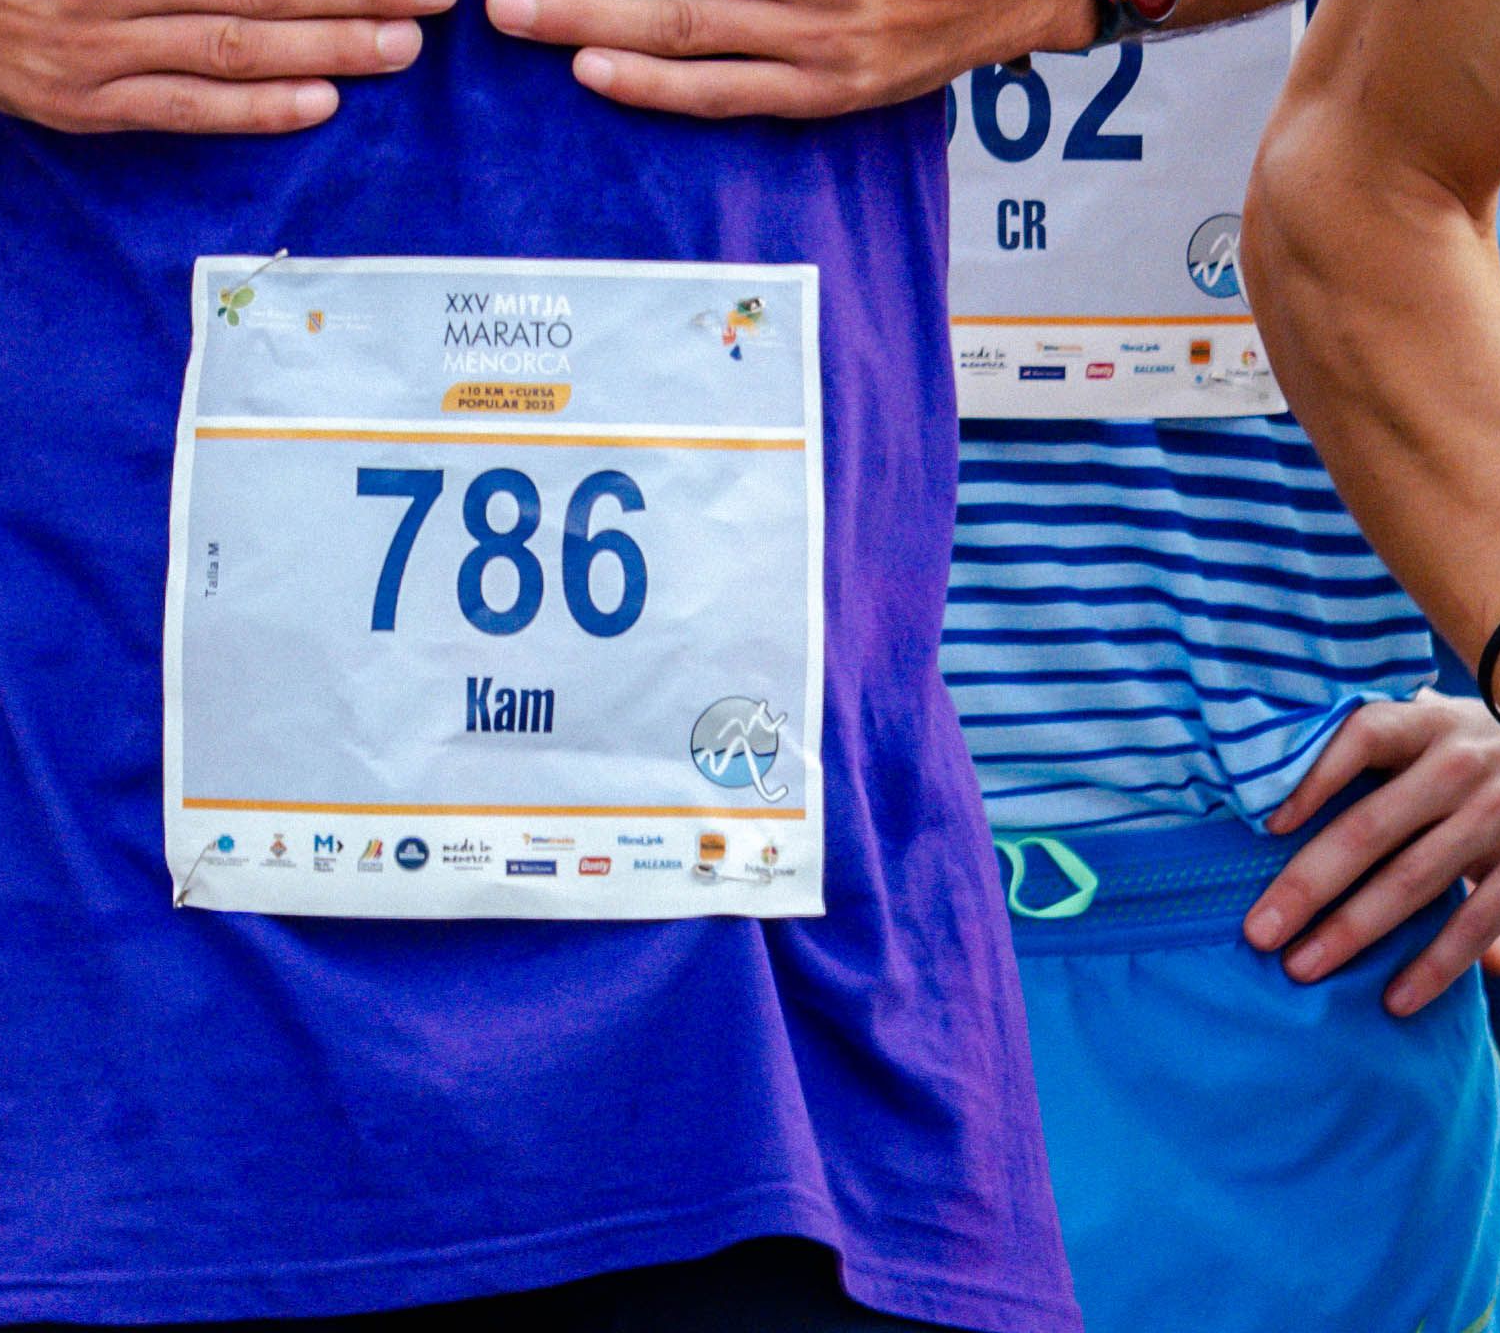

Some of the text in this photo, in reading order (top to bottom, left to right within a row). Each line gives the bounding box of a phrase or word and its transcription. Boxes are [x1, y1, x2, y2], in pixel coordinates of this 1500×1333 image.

[946, 37, 1143, 164] 62
[996, 198, 1048, 251] CR
[445, 292, 572, 317] XXV MITJA
[444, 315, 573, 348] MARATÓ
[442, 351, 572, 375] MENORCA
[458, 398, 519, 410] POPULAR
[205, 542, 220, 598] Talla M
[355, 465, 649, 638] 786
[465, 677, 555, 733] Kam
